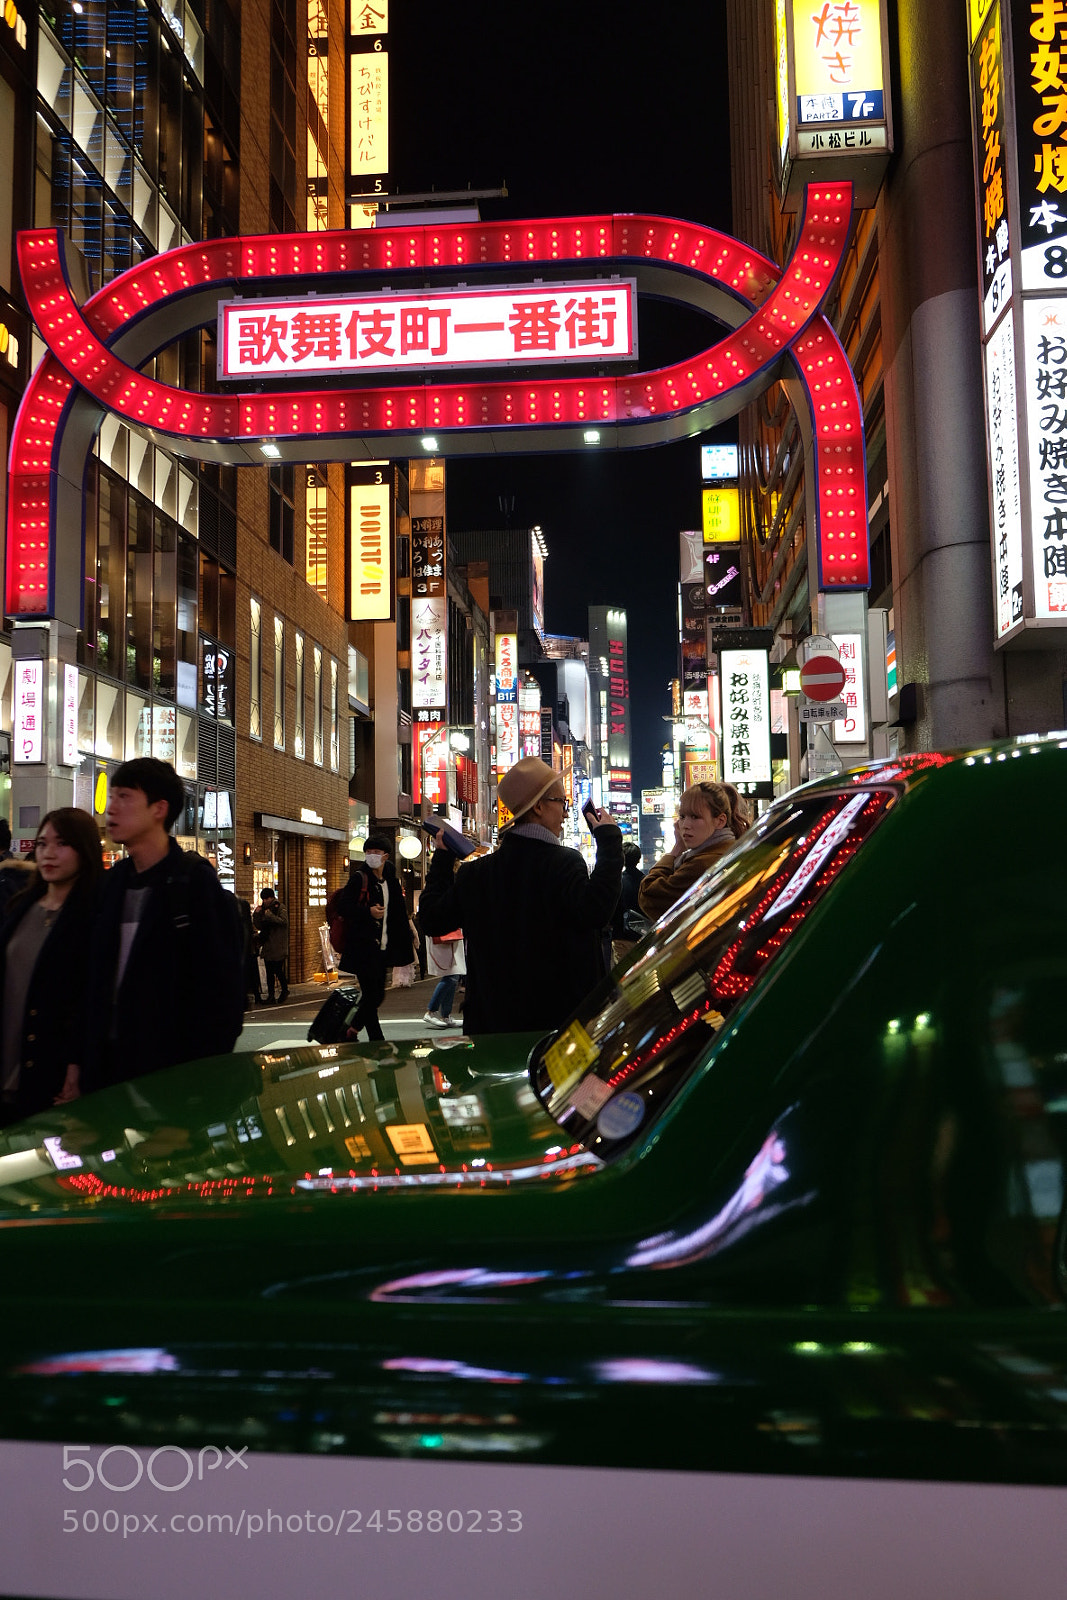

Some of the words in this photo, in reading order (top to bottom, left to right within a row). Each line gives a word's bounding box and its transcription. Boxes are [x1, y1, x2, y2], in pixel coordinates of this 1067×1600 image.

[374, 39, 382, 52] 6
[847, 92, 875, 118] 7F
[357, 67, 376, 162] ちびすけバル
[806, 109, 839, 121] PART2
[811, 131, 872, 150] 小松ビル
[374, 179, 382, 192] 5
[238, 297, 618, 366] 歌舞伎町一番街
[375, 471, 383, 485] 3
[413, 519, 443, 531] 小料理
[360, 505, 384, 596] DOUTOR
[706, 554, 720, 564] 4F
[417, 582, 440, 593] 3F
[609, 639, 630, 735] HUMAX
[422, 697, 435, 706] 3F
[497, 692, 516, 701] B1F
[22, 667, 37, 754] 劇場通り
[417, 710, 441, 722] 焼肉
[802, 706, 844, 719] 自転車を除く
[729, 672, 751, 774] お好み焼本陣
